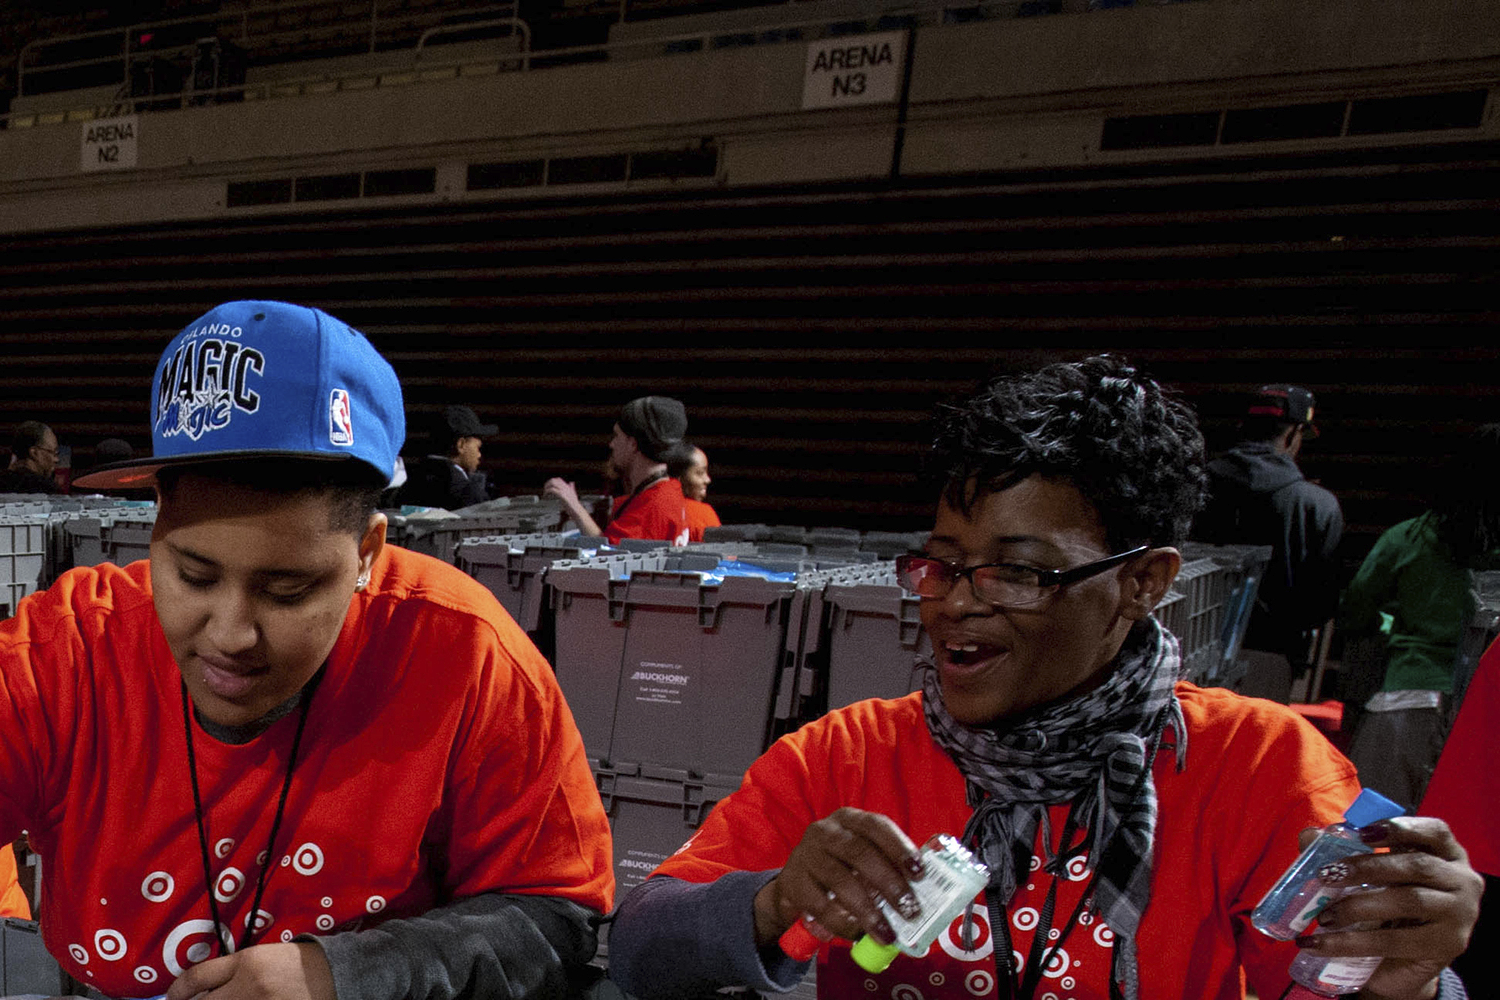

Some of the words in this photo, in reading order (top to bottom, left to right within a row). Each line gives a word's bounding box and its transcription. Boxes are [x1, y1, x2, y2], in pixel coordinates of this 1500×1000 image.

[812, 43, 893, 74] ARENA
[832, 73, 867, 97] N3
[86, 123, 134, 143] ARENA
[98, 145, 119, 163] N2
[155, 339, 265, 432] MAGIC
[639, 672, 688, 684] BUCKHORN
